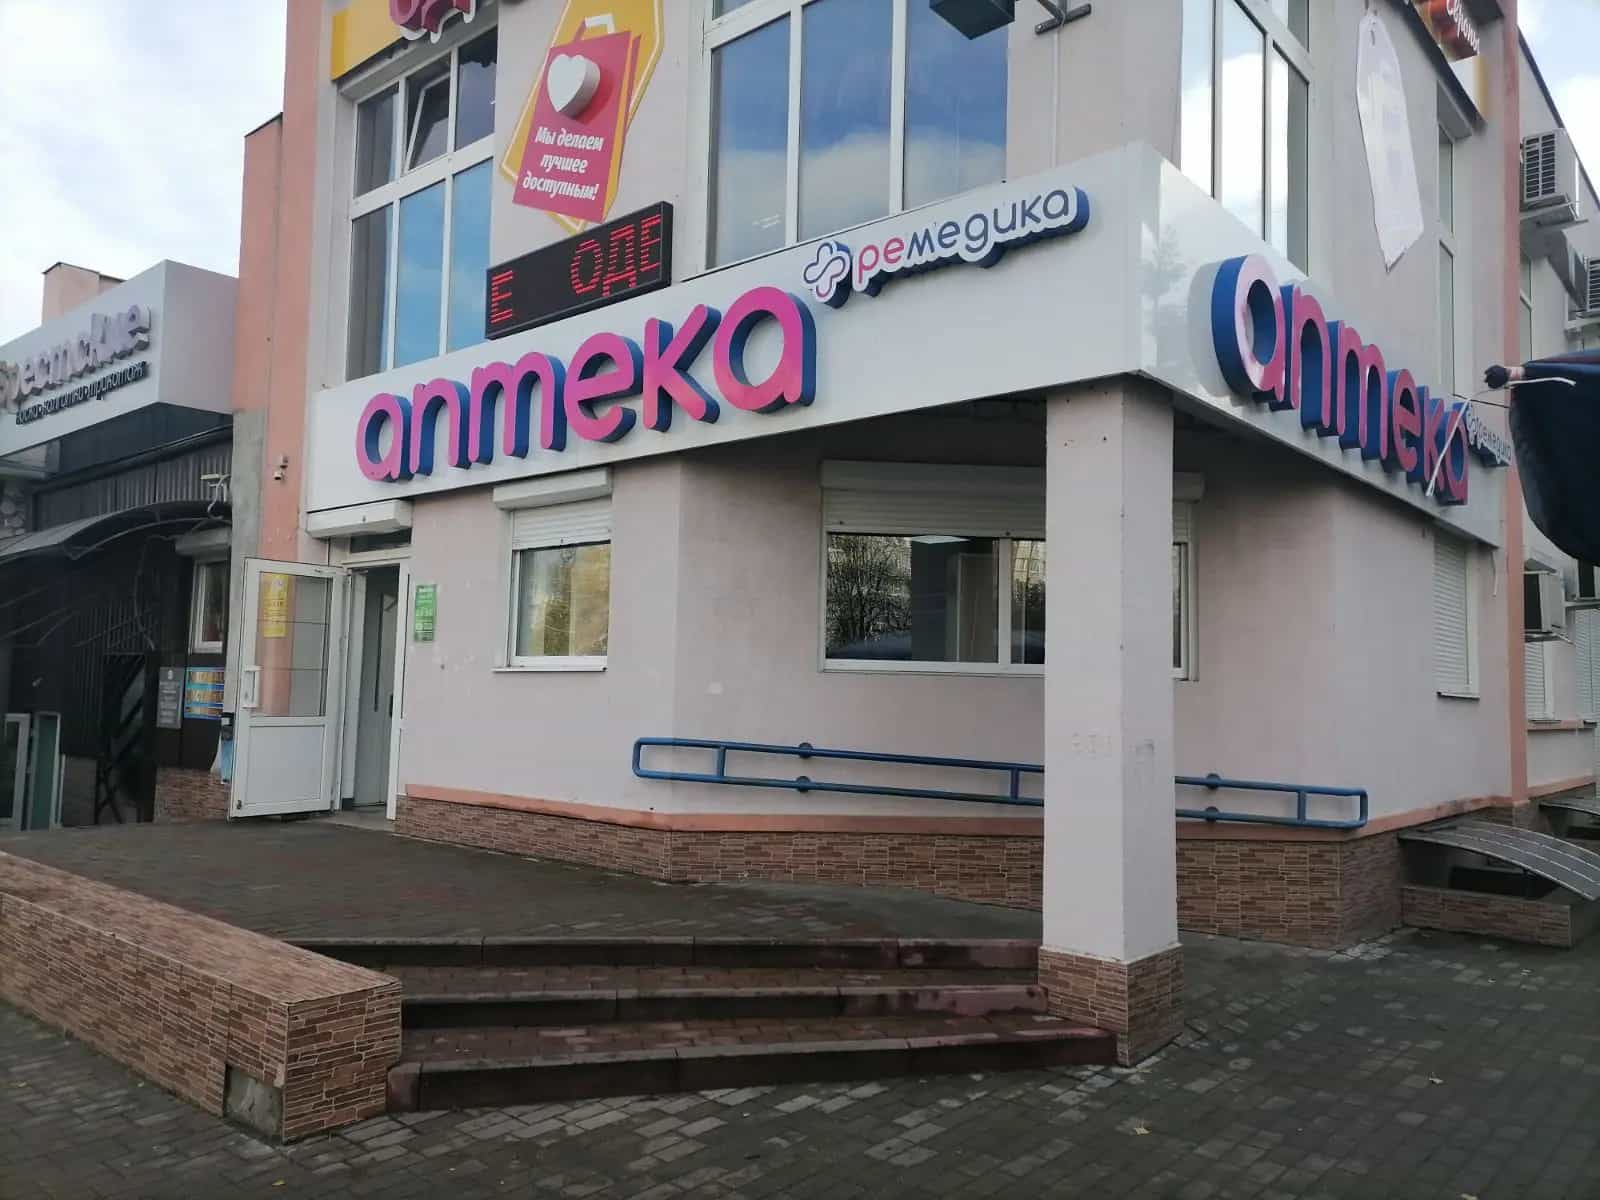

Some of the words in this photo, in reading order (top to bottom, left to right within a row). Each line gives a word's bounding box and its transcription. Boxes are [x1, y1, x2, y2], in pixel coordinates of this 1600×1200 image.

[522, 170, 600, 200] доступным!
[534, 126, 557, 145] Мы
[557, 127, 605, 151] делаем
[540, 153, 589, 173] лучшее
[490, 269, 514, 324] Е
[570, 213, 662, 298] ОДЕ
[858, 189, 1069, 284] ремедика
[356, 286, 814, 484] аптека
[1213, 255, 1469, 505] аптека
